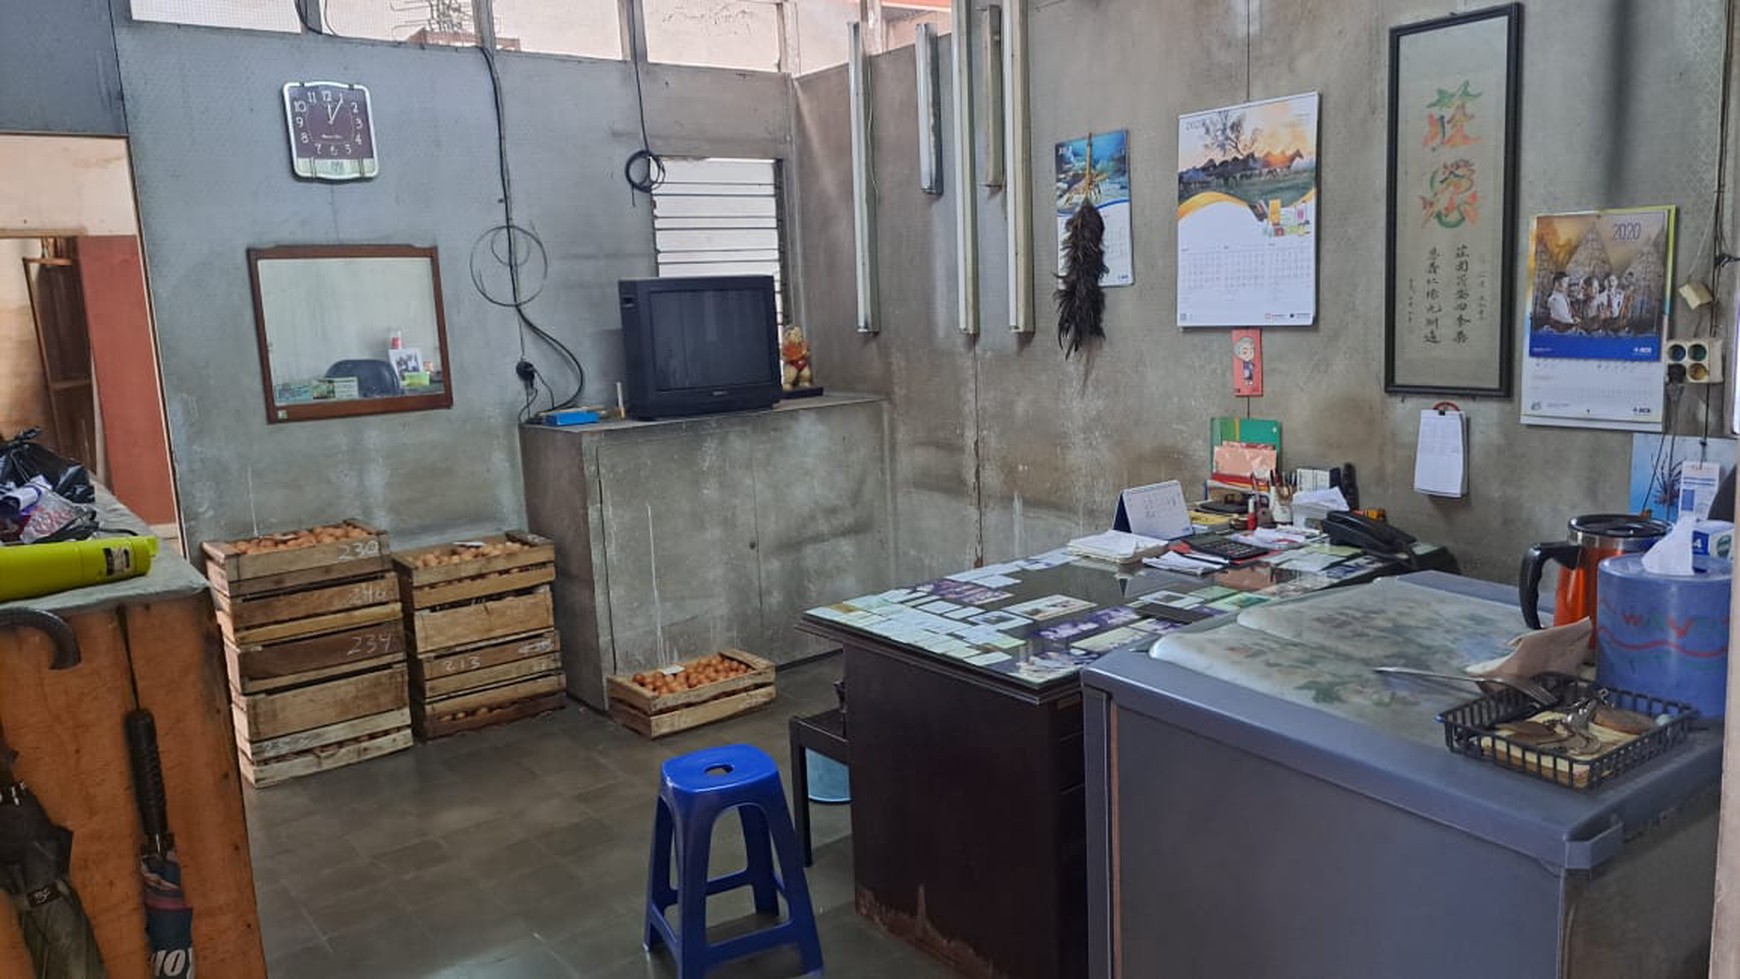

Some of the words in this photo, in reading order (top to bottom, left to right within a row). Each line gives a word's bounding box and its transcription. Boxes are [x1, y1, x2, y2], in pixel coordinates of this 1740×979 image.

[307, 91, 317, 104] 11
[321, 90, 333, 102] 12
[293, 101, 307, 113] 10
[351, 101, 359, 114] 2
[296, 116, 304, 128] 9
[355, 117, 363, 130] 3
[300, 131, 309, 144] 8
[1613, 222, 1641, 241] 2020
